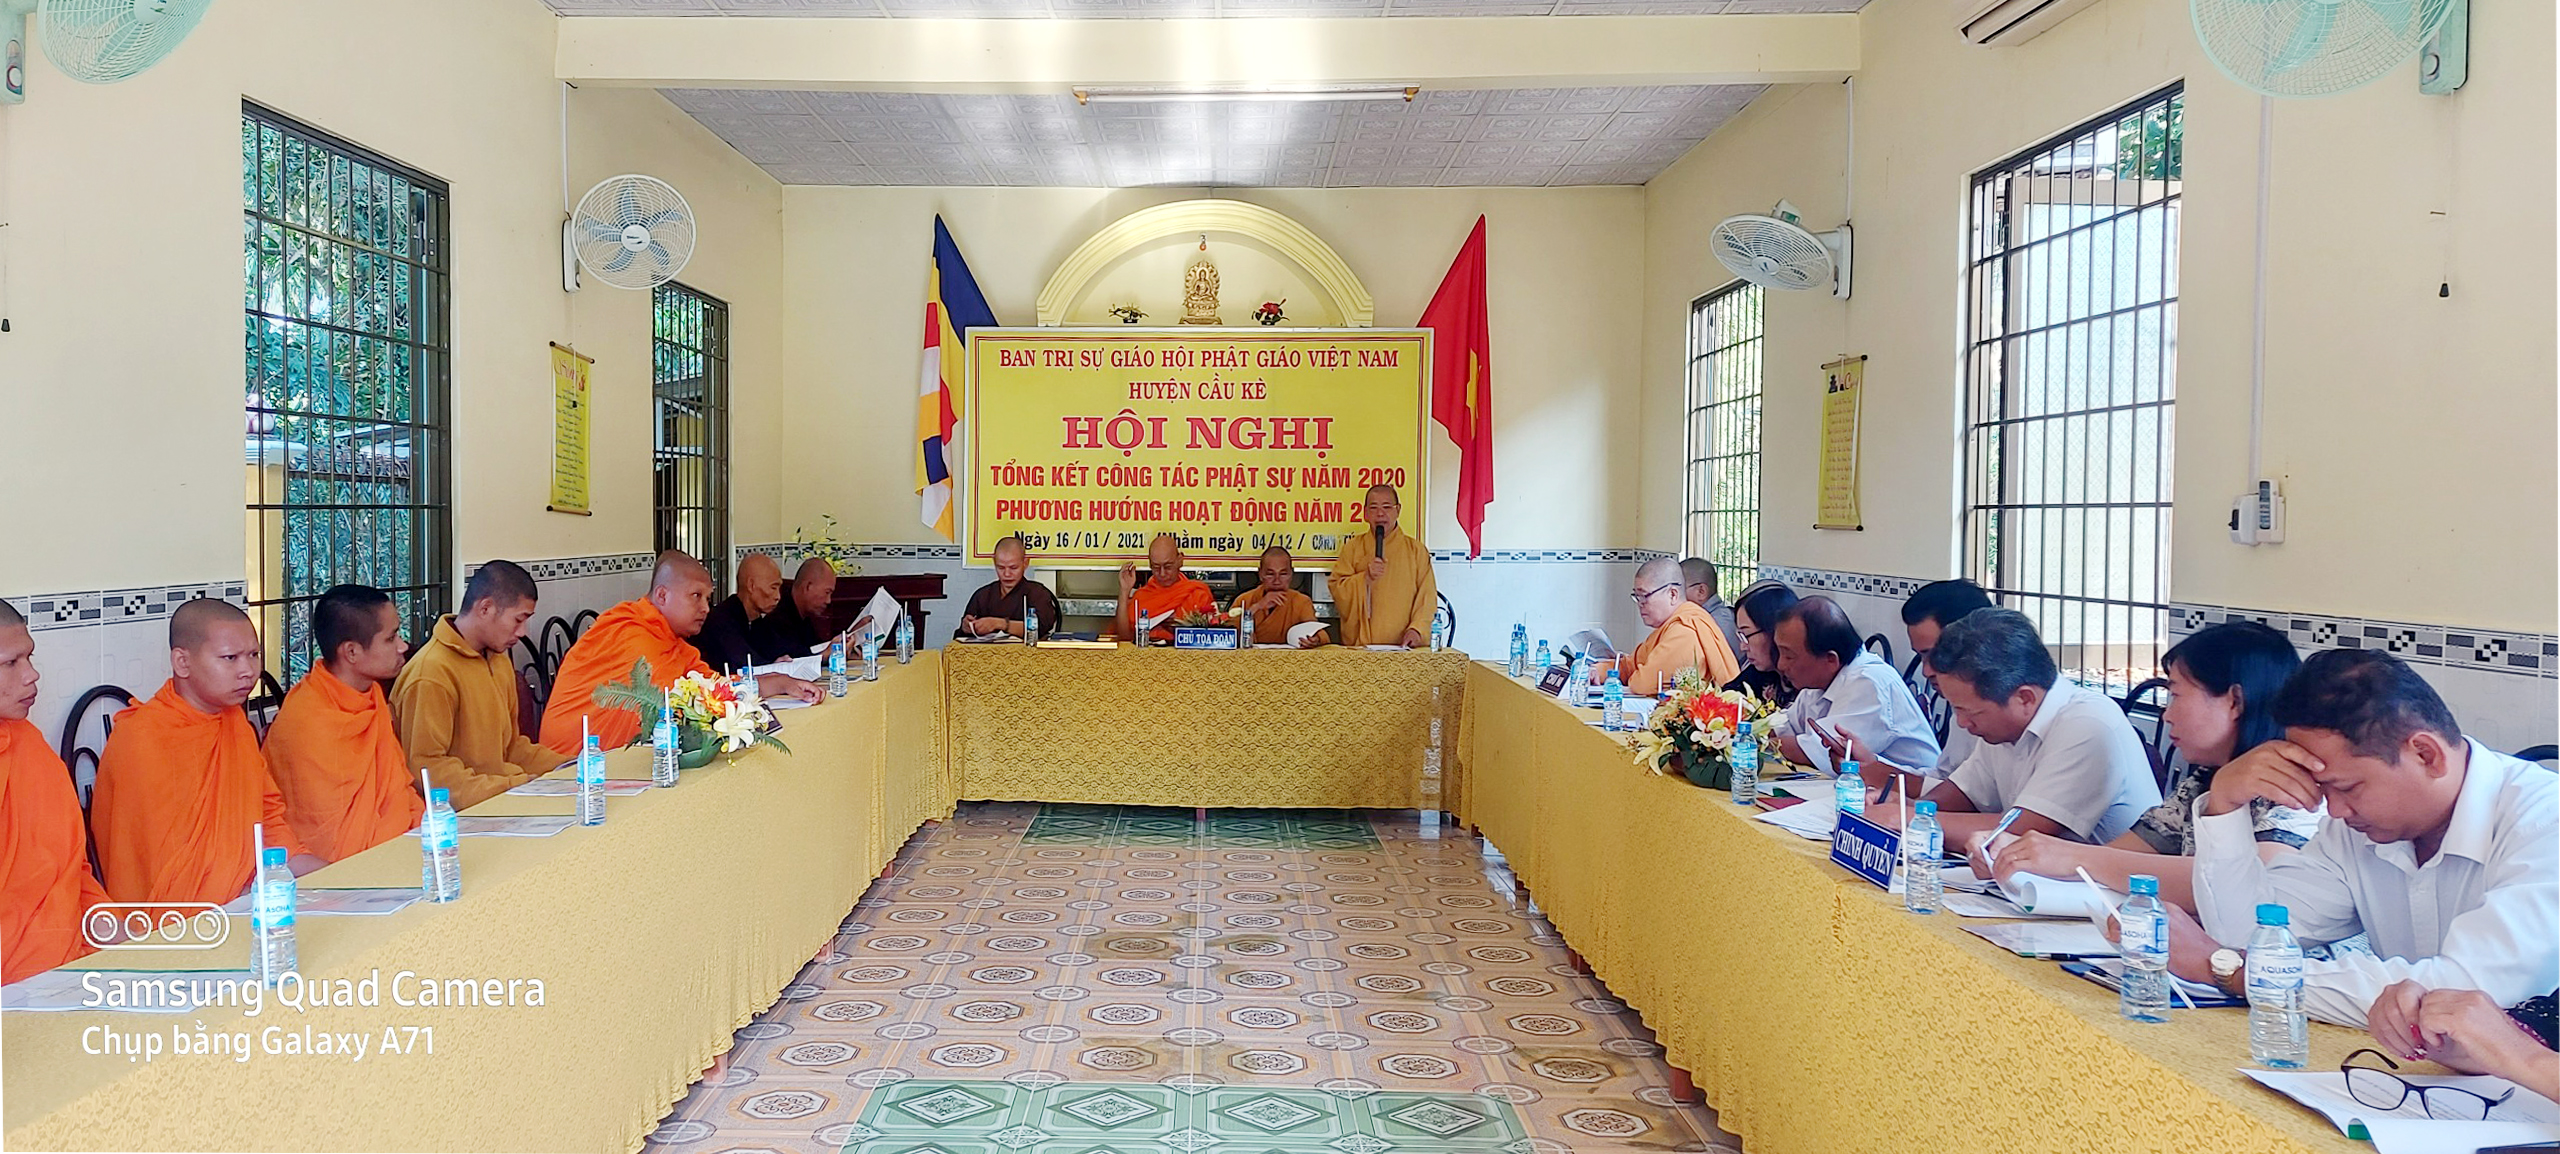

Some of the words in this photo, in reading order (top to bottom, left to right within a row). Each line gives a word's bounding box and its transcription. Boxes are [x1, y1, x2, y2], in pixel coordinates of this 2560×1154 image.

[1000, 350, 1036, 367] BAN
[1042, 350, 1074, 372] TRỊ
[1080, 347, 1104, 372] SỰ
[1111, 345, 1155, 367] GIÁO
[1161, 346, 1194, 372] HỘI
[1200, 345, 1250, 372] PHẬT
[1257, 346, 1301, 367] GIÁO
[1307, 345, 1351, 372] VIỆT
[1357, 350, 1399, 367] NAM
[1128, 377, 1191, 404] HUYỆN
[1198, 373, 1235, 400] CẦU
[1241, 377, 1267, 400] KÈ
[1062, 408, 1168, 457] HỘI
[1186, 416, 1334, 459] NGHỊ
[990, 458, 1045, 487] TỔNG
[1051, 460, 1089, 487] KẾT
[1096, 463, 1152, 487] CÔNG
[1160, 461, 1199, 487] TÁC
[1206, 463, 1258, 492] PHẬT
[1266, 467, 1296, 492] SỰ
[1302, 463, 1350, 488] NĂM
[1358, 467, 1405, 488] 2020
[996, 500, 1082, 521] PHƯƠNG
[1089, 495, 1162, 521] HƯỚNG
[1169, 500, 1222, 526] HOẠT
[1230, 498, 1287, 526] ĐỘNG
[1294, 499, 1342, 523] NĂM
[1056, 532, 1069, 548] 16
[1085, 532, 1099, 548] 01
[1118, 532, 1145, 548] 2021
[1209, 533, 1244, 552] ngày
[1178, 630, 1194, 644] CHỦ
[1196, 633, 1212, 646] TỌA
[1835, 826, 1865, 861] CHÍNH
[1861, 837, 1894, 877] QUYỀN
